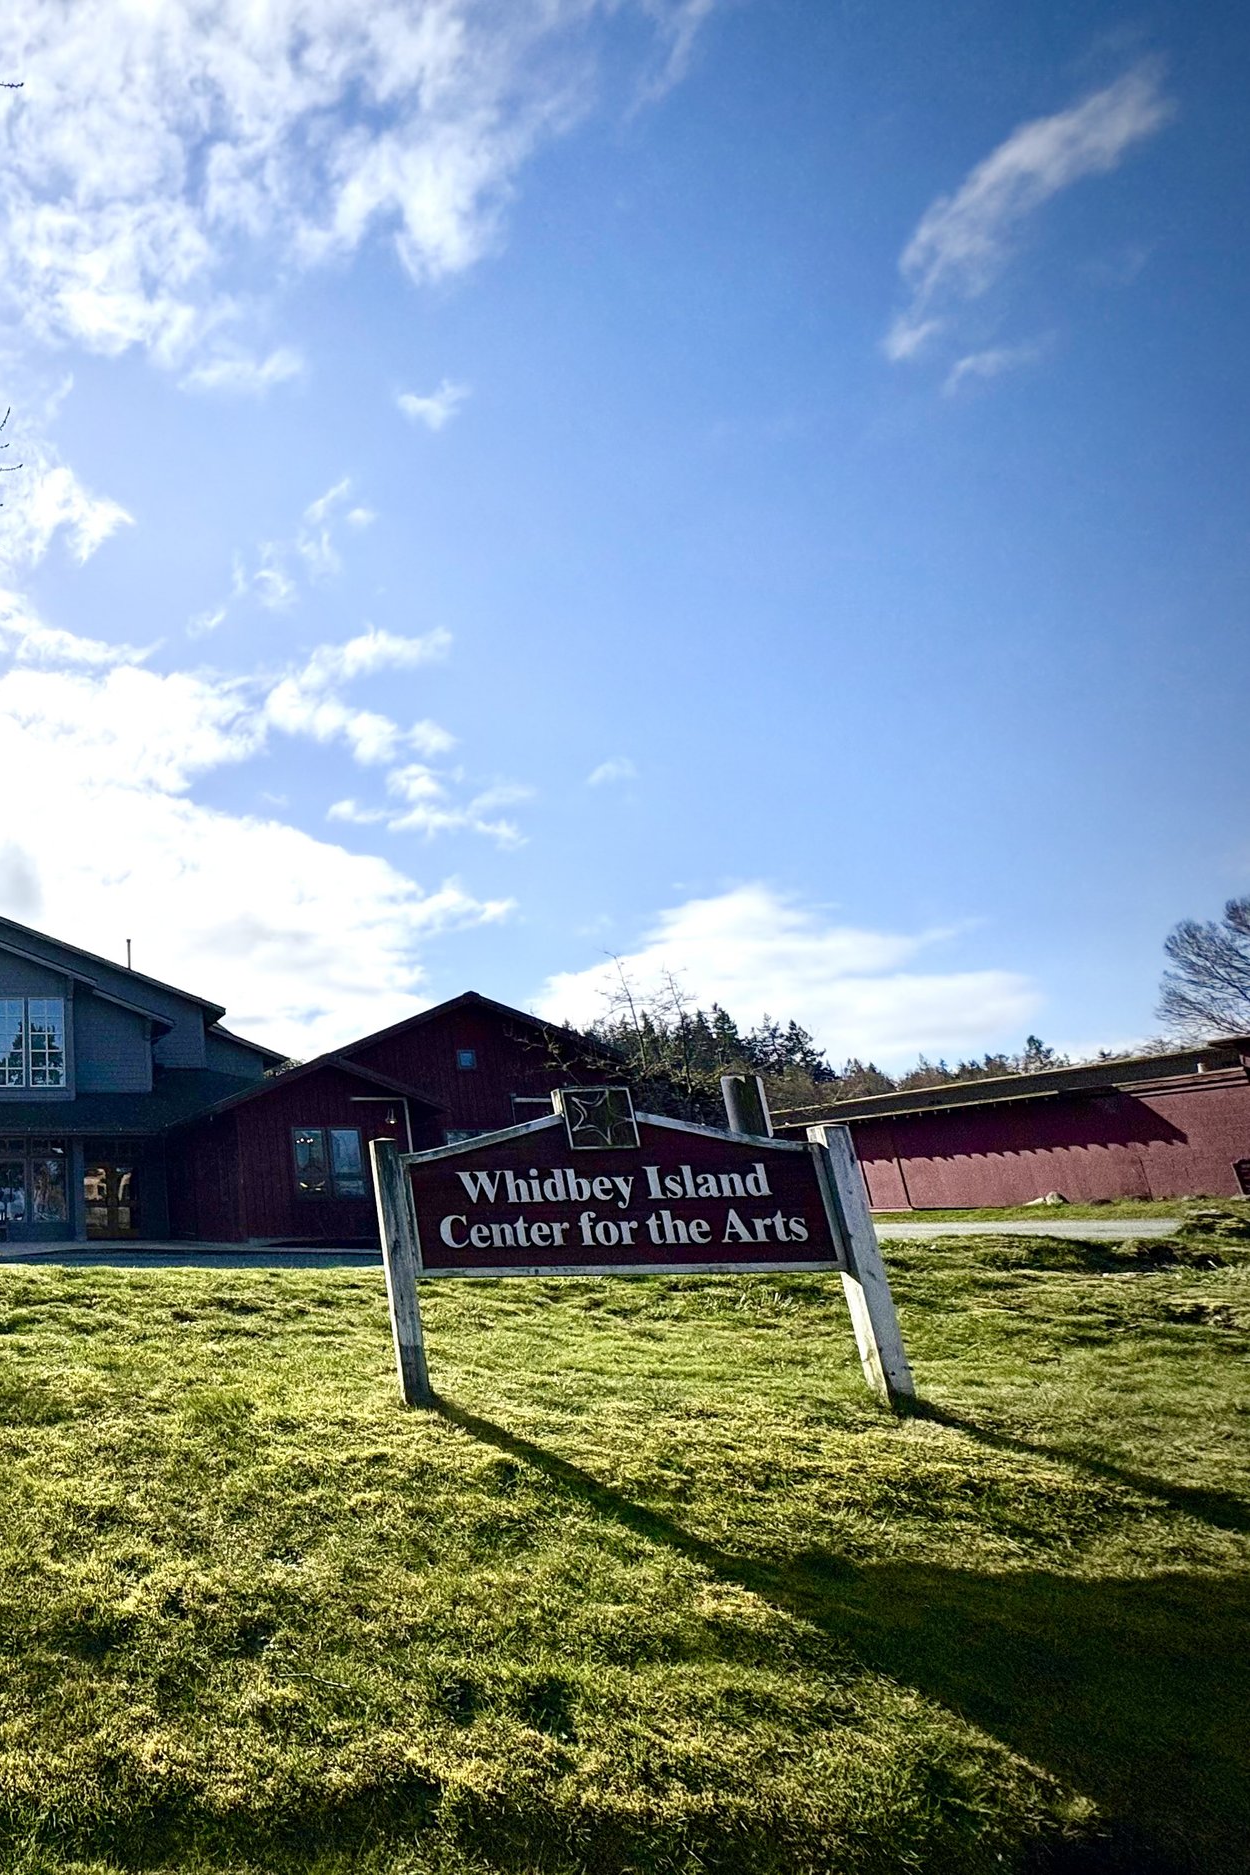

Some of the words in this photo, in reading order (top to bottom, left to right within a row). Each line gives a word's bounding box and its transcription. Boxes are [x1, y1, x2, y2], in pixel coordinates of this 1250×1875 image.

[455, 1167, 634, 1209] Whidbey
[642, 1163, 773, 1200] Island
[439, 1214, 570, 1249] Center
[578, 1211, 639, 1246] for
[646, 1209, 712, 1245] the
[721, 1208, 809, 1244] Arts
